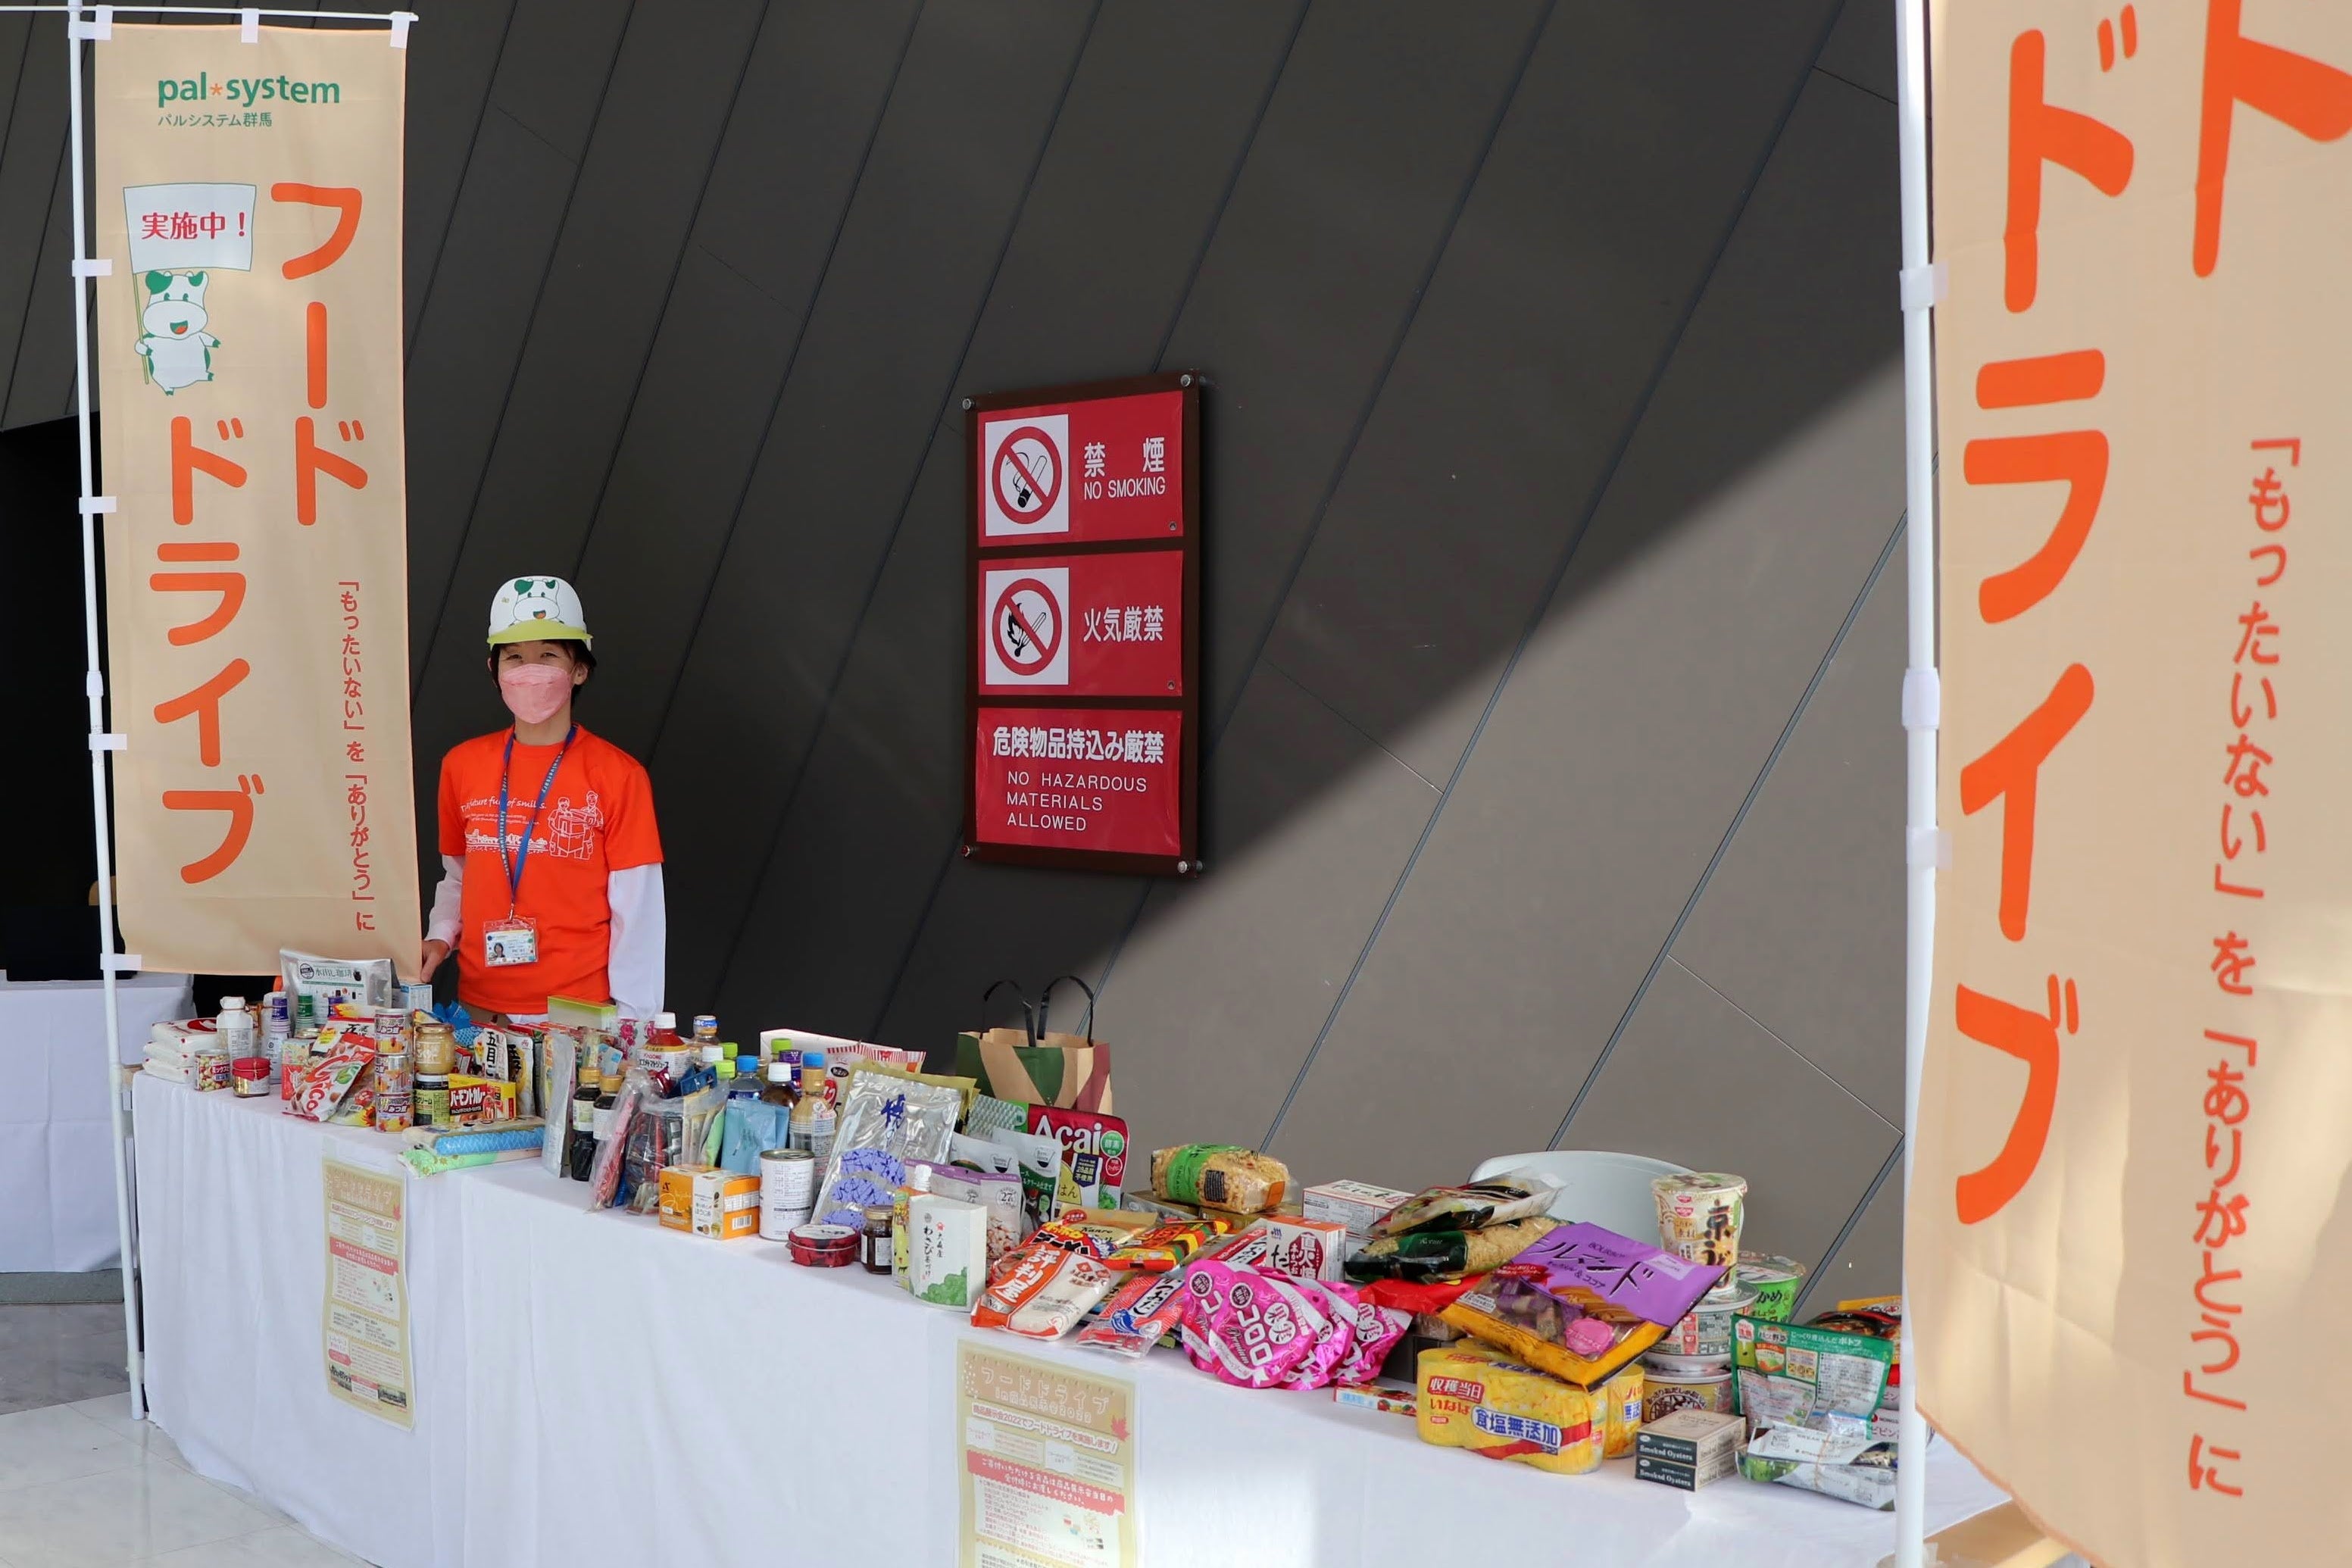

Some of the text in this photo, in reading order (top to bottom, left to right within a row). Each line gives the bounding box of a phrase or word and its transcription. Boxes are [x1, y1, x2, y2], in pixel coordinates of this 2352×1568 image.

[158, 72, 340, 108] pal system
[158, 112, 273, 127] パルシステム群馬
[270, 183, 369, 526] フード
[1084, 436, 1165, 478] 禁 煙
[1084, 476, 1166, 500] NO SMOKING
[1083, 605, 1164, 642] 火気厳禁
[149, 416, 264, 885] ドライブ
[992, 726, 1164, 764] 危険物品持込み厳禁
[1007, 770, 1147, 793] NO HAZARDOUS
[517, 799, 547, 809] smils.
[1007, 792, 1103, 811] MATERIALS
[1007, 812, 1087, 832] ALLOWED
[450, 1087, 486, 1107] バーモントカレー
[1035, 1114, 1102, 1156] Acai
[1429, 1377, 1482, 1400] 収穫当日
[1429, 1398, 1470, 1416] いなば
[1476, 1408, 1559, 1447] 食塩無添加
[1639, 1445, 1666, 1456] Smoked
[1666, 1449, 1694, 1461] Oysters
[1639, 1469, 1692, 1487] Smoked Oysters
